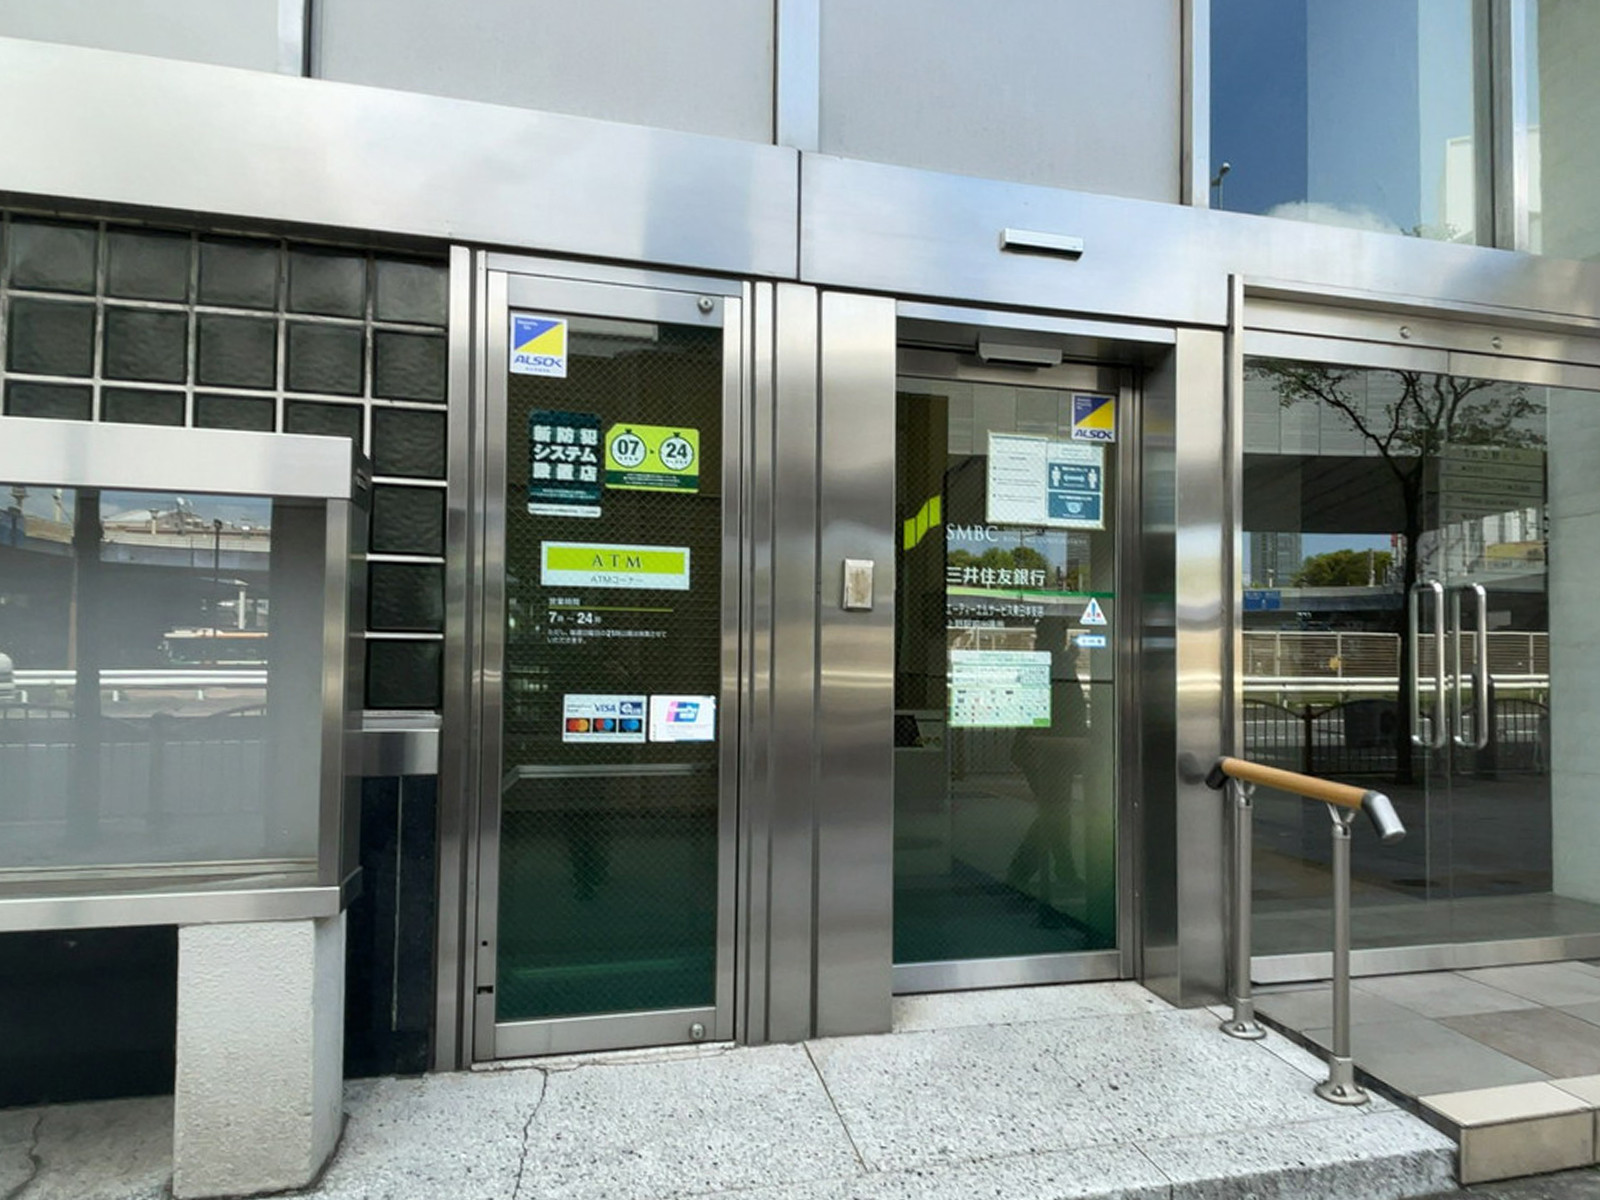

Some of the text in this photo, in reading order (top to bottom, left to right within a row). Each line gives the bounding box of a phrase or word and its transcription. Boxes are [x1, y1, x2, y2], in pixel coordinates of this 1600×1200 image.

[514, 354, 563, 369] ALSOK
[1074, 428, 1113, 440] ALSOK
[533, 444, 597, 463] システム
[617, 439, 640, 456] 07
[665, 442, 688, 459] 24
[945, 522, 999, 542] SMBC
[591, 553, 642, 569] ATM
[589, 574, 645, 585] ATMコーナー
[945, 566, 1047, 587] 三井住友銀行
[593, 703, 617, 714] VISA
